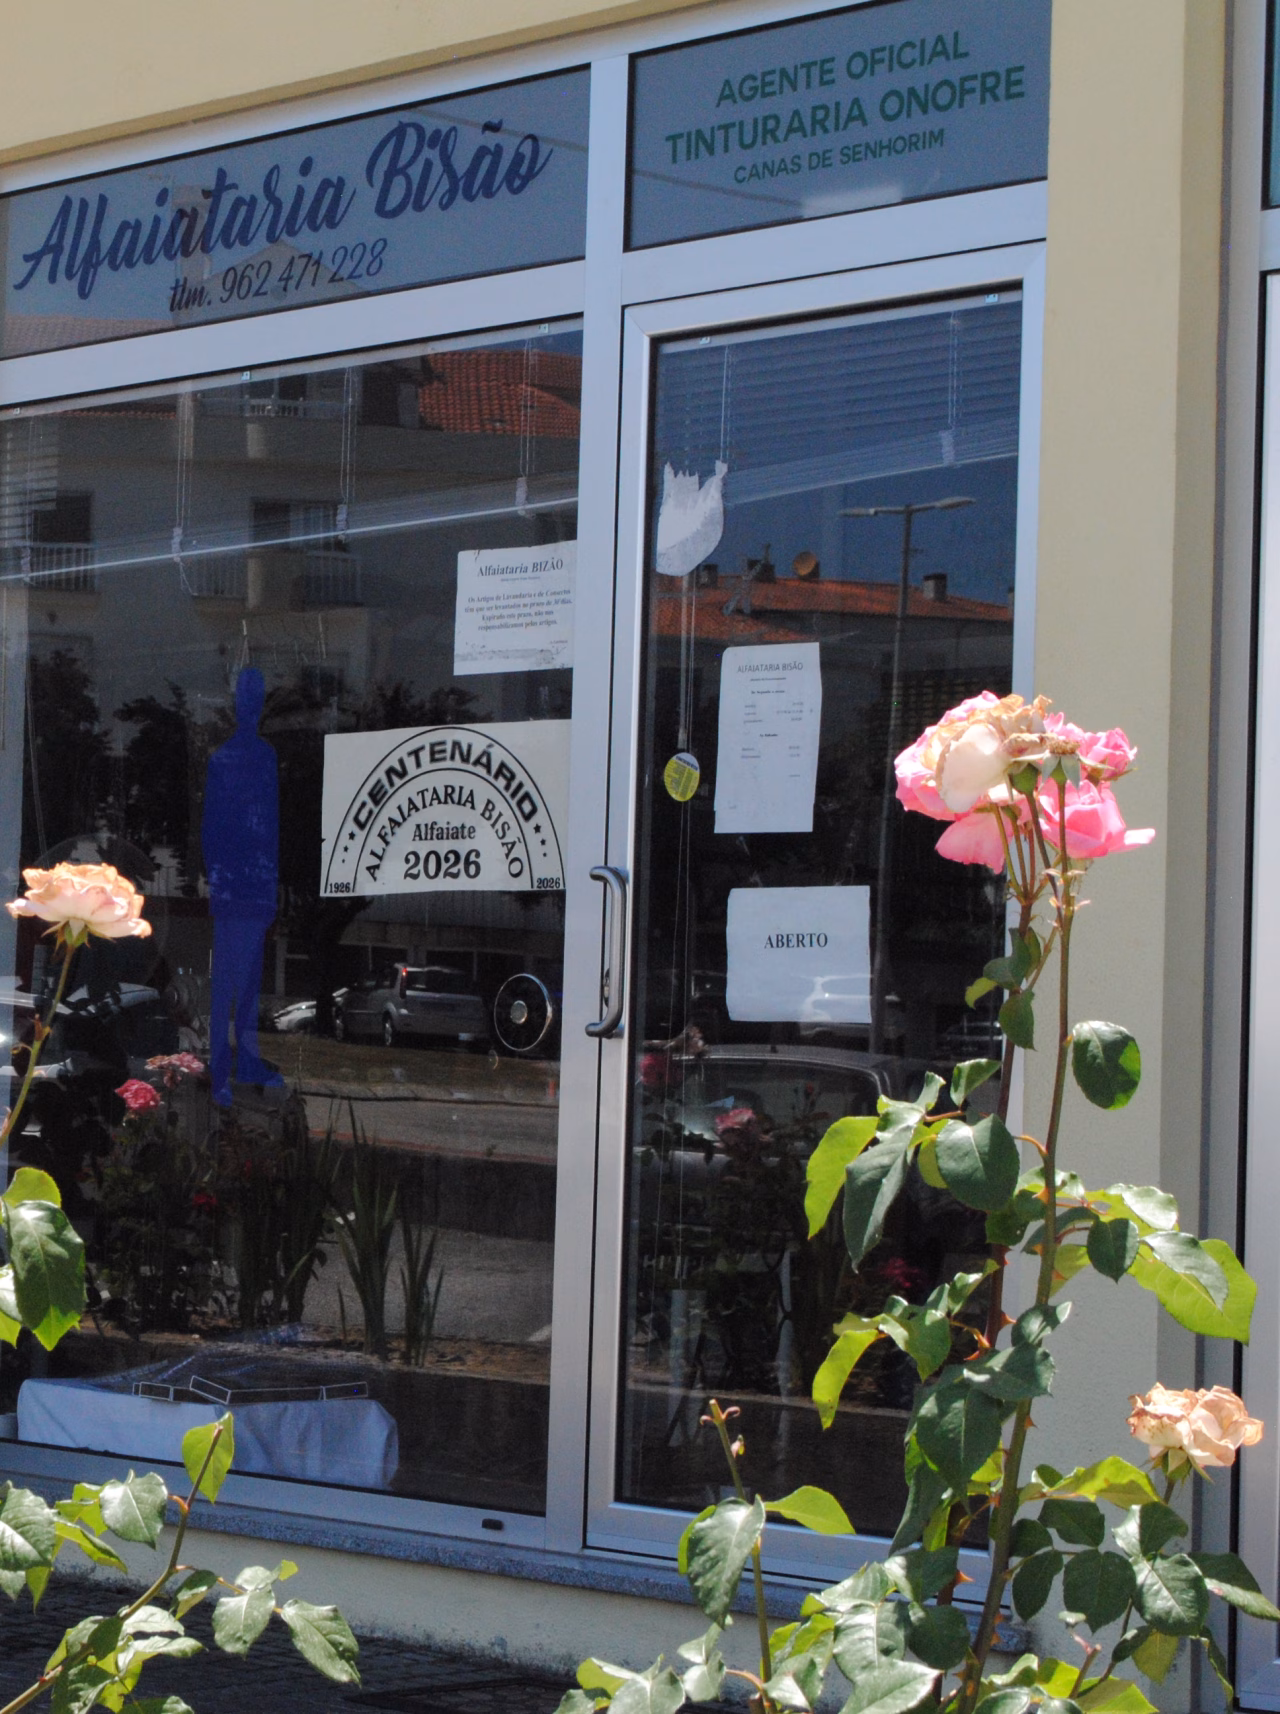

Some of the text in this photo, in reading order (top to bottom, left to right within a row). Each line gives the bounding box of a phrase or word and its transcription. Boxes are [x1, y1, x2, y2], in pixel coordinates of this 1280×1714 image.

[715, 31, 970, 108] AGENTE OFICIAL
[666, 65, 1026, 164] TINTURARIA ONOFRE
[733, 128, 945, 183] CANAS DE SENHORIM
[13, 119, 553, 300] Alfaiataria Bisão
[169, 239, 387, 313] tlm. 962 471 228
[477, 563, 528, 577] Alfaiataria
[737, 661, 803, 673] ALFAIATARIA BISÃO
[353, 739, 538, 831] CENTENÁRIO
[365, 784, 524, 881] ALFAIATARIA BISÃO
[412, 821, 476, 841] Alfaiate
[403, 848, 481, 880] 2026
[536, 877, 560, 889] 2026
[329, 882, 351, 893] 1926
[764, 933, 828, 949] ABERTO
